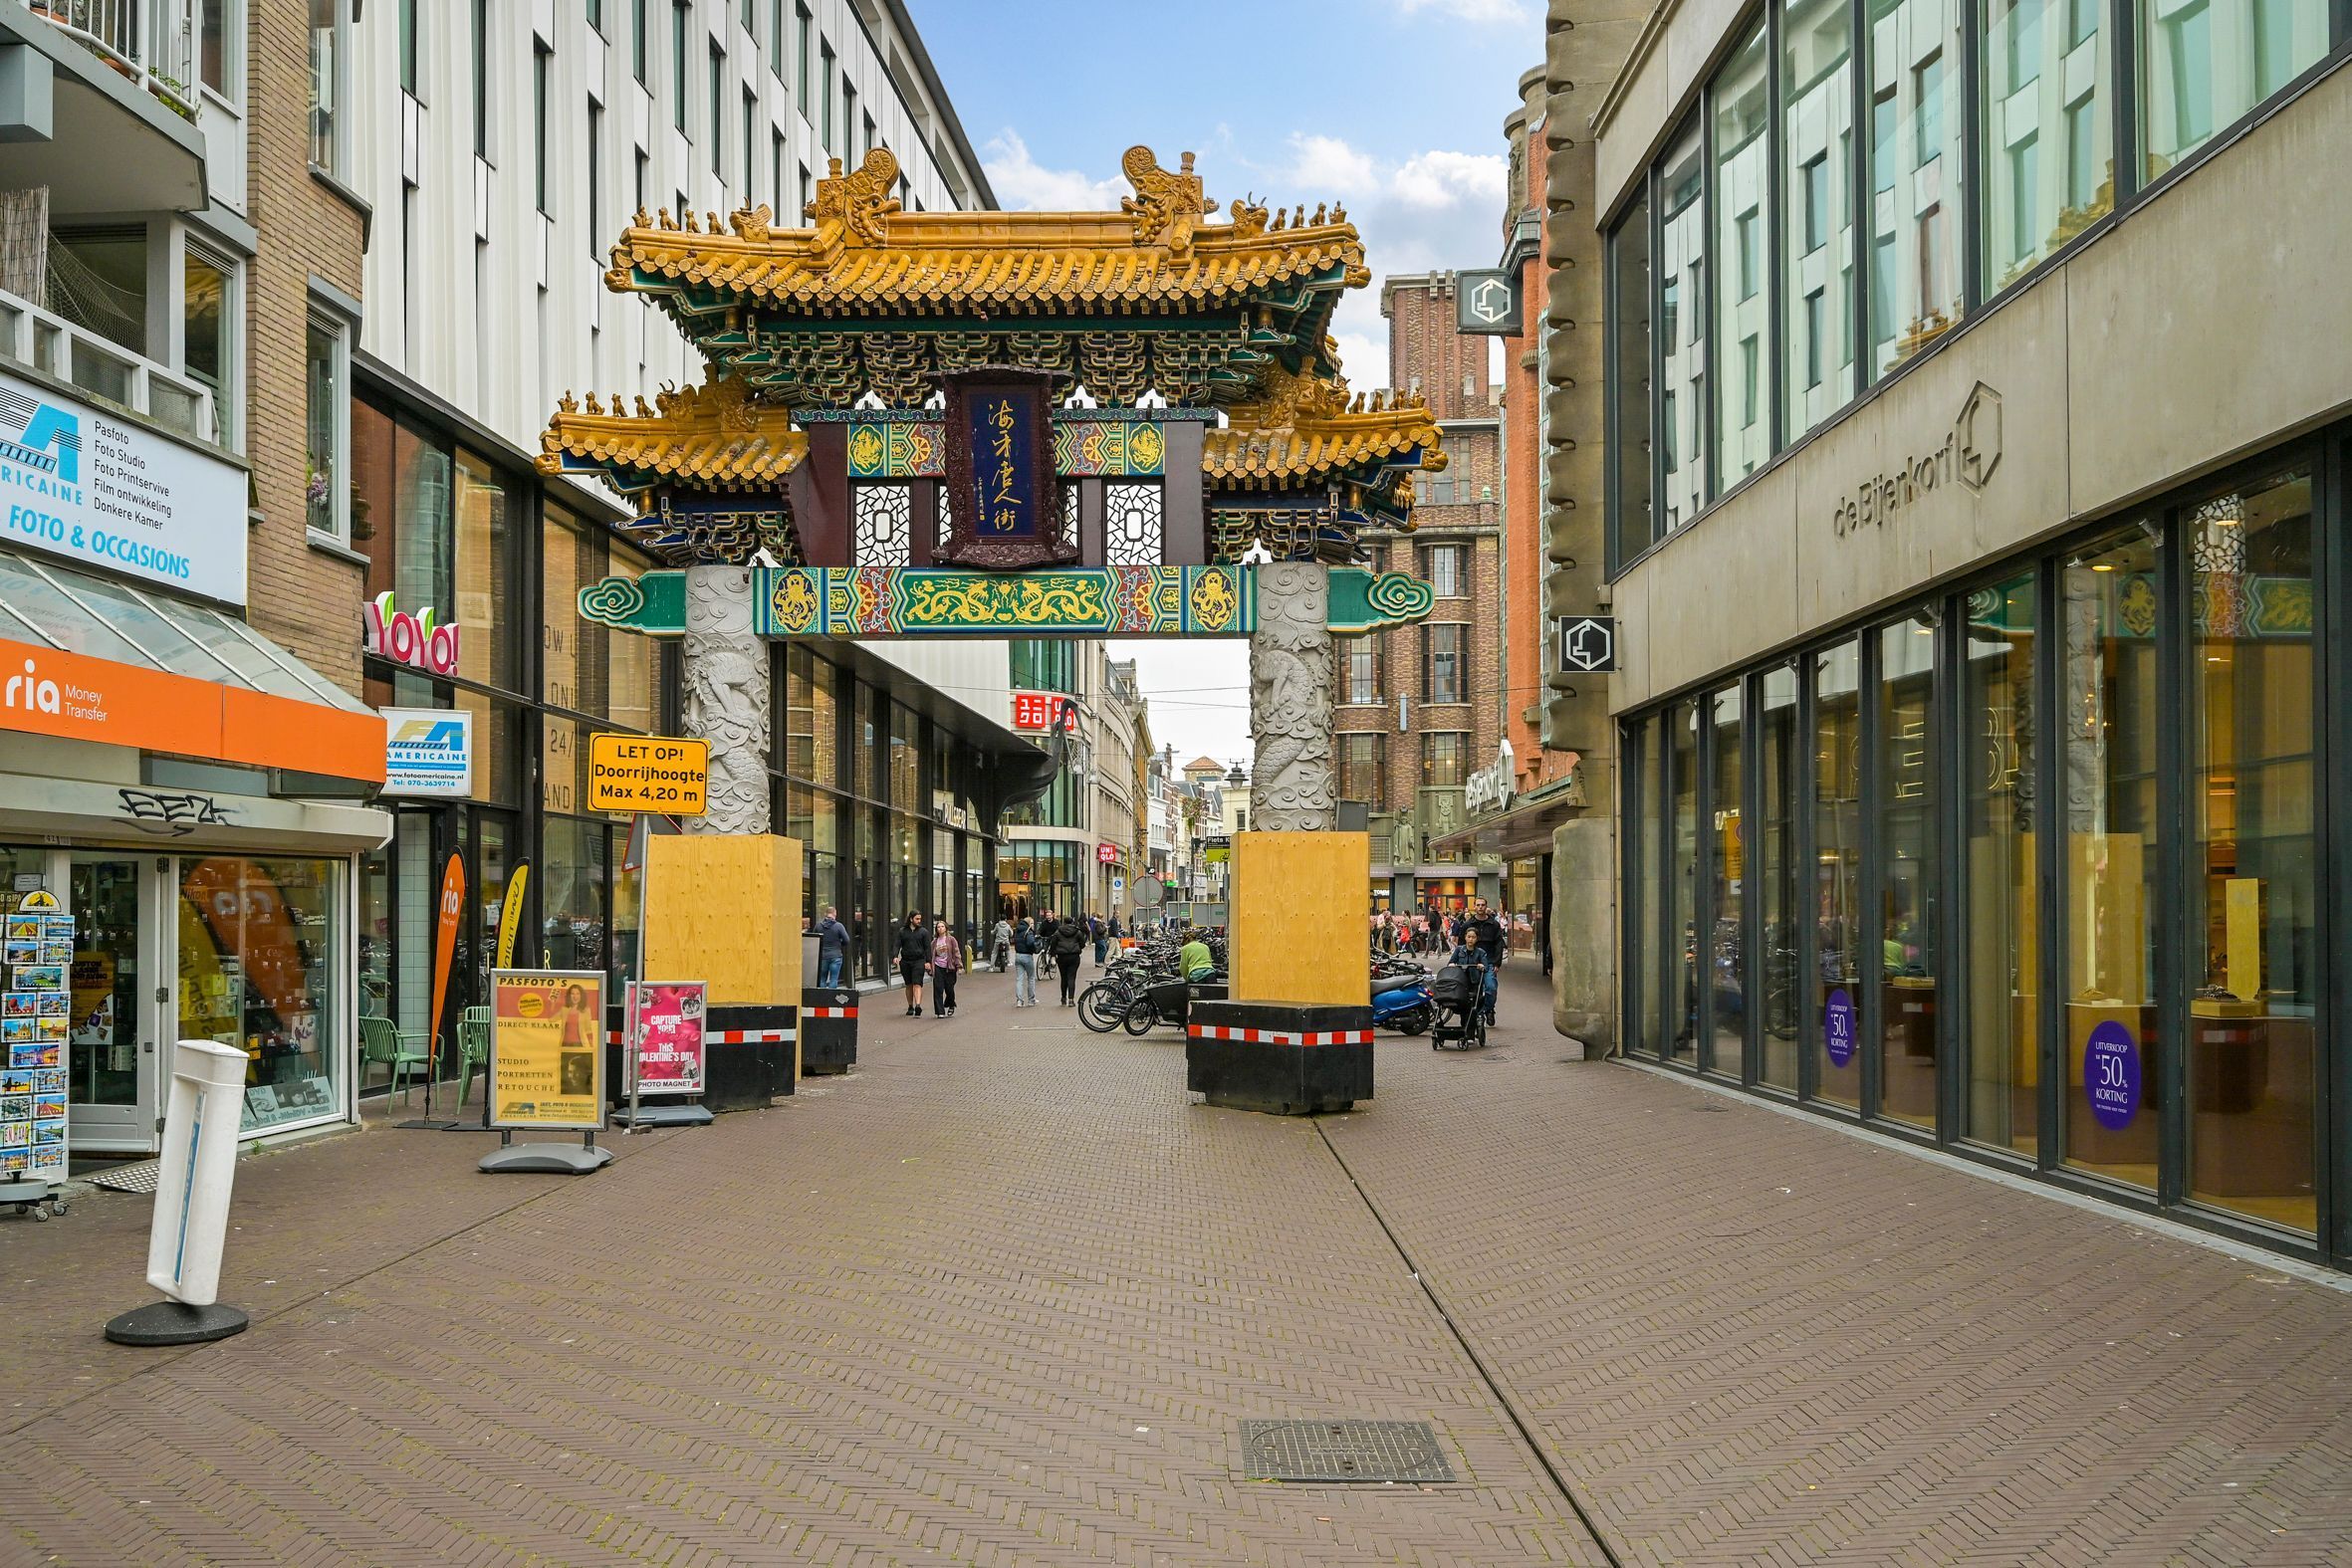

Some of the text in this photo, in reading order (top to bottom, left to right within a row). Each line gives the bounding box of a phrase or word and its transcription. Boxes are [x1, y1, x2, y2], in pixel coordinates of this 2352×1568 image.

[95, 420, 129, 445] Pasfoto
[95, 440, 145, 470] Foto Studio
[1, 465, 83, 506] RICAINE
[95, 459, 169, 497] Foto Printservive
[94, 478, 172, 519] Film ontwikkeling
[94, 497, 163, 531] Donkere Kamer
[9, 505, 190, 579] FOTO & OCCASIONS
[6, 659, 60, 715] ria
[65, 684, 103, 706] Money
[65, 702, 108, 722] Transfer
[386, 752, 467, 761] AMERICAINE
[617, 745, 684, 761] LET OP!
[594, 764, 705, 784] Doorrijhoogte
[600, 784, 698, 801] Max 4,20 m
[443, 877, 458, 915] ria
[650, 1015, 682, 1024] CAPTURE
[658, 1042, 674, 1052] THIS
[2095, 1041, 2128, 1053] UITVERKOOP
[2095, 1087, 2128, 1104] KORTING
